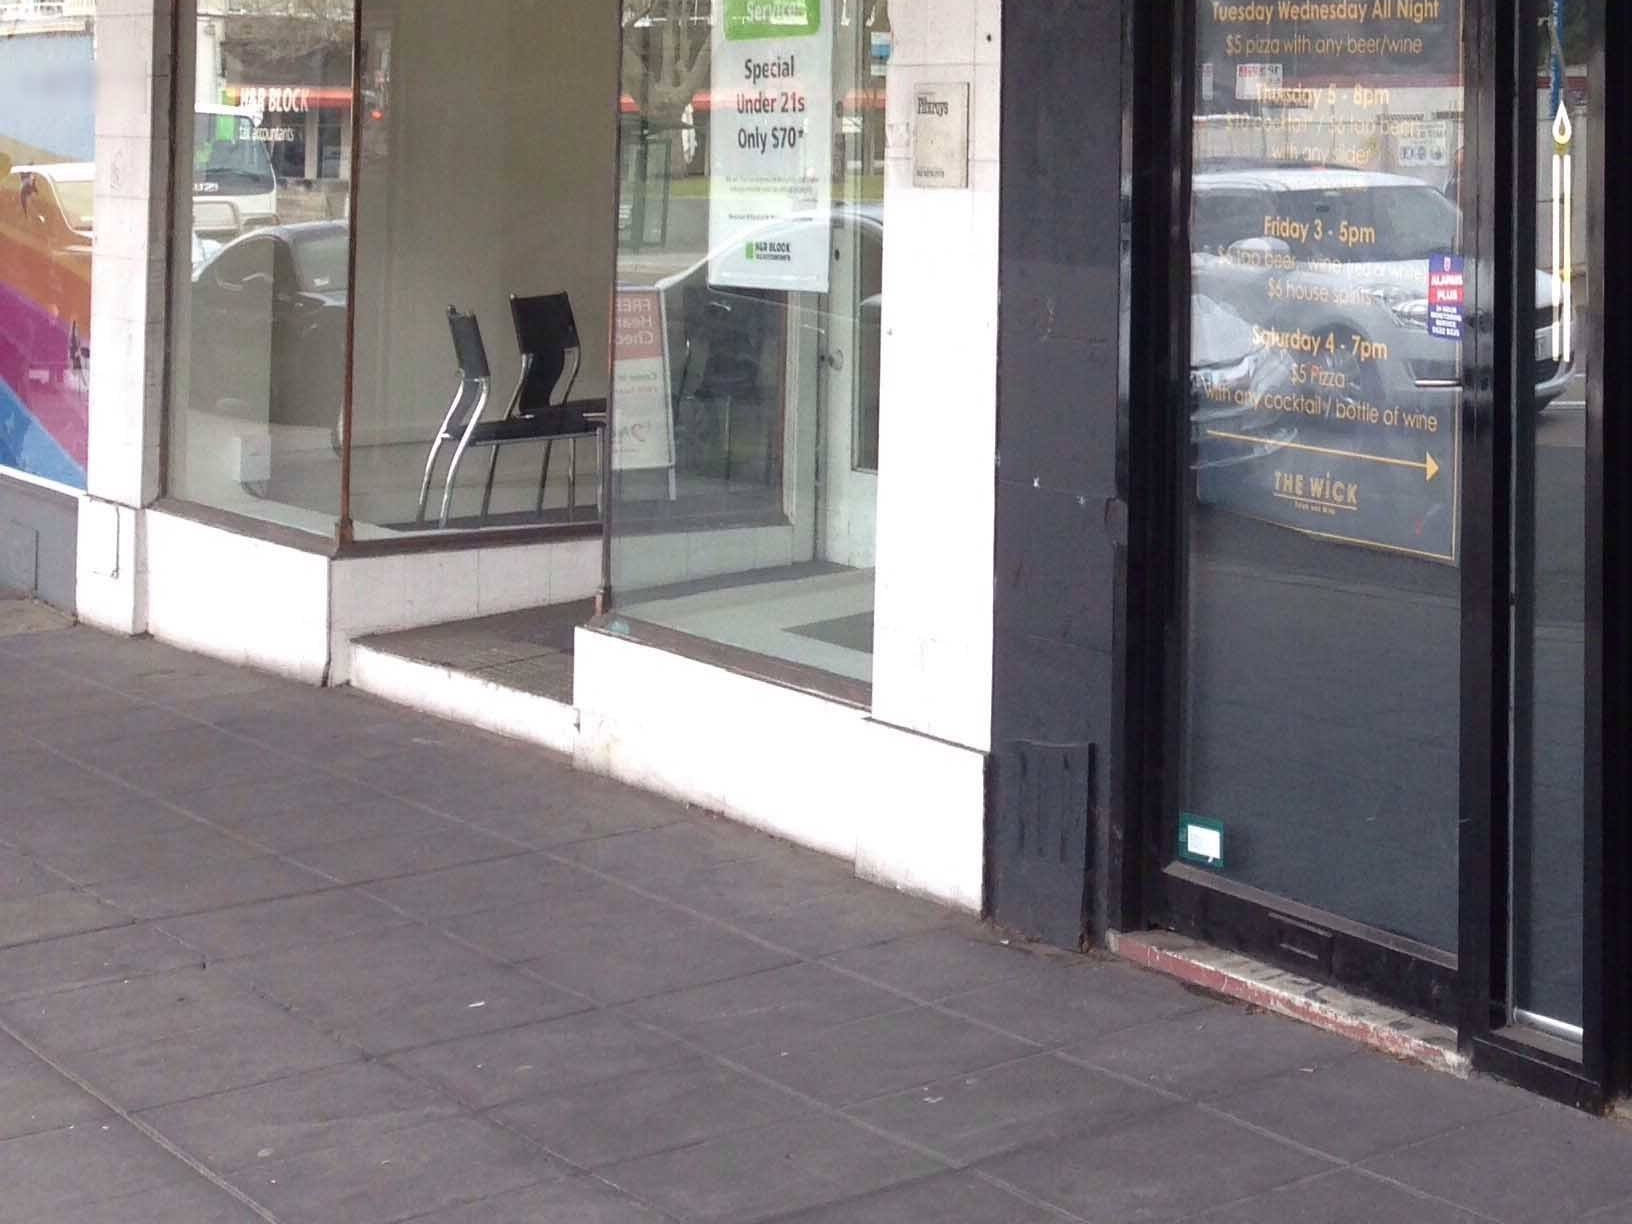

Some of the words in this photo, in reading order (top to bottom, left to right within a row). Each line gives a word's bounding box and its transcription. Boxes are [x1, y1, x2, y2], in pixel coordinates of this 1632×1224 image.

[1213, 0, 1273, 24] Tuesday
[1397, 0, 1440, 23] Night
[1225, 35, 1242, 54] $5
[1246, 36, 1281, 56] pizza
[1283, 34, 1311, 53] with
[1315, 38, 1343, 57] any
[1347, 34, 1422, 55] beer/wine
[745, 55, 794, 85] Special
[737, 91, 775, 114] Under
[780, 92, 805, 112] 21s
[738, 127, 767, 154] Only
[1264, 216, 1310, 242] Friday
[1314, 219, 1323, 241] 3
[1338, 219, 1375, 248] 5pm
[1286, 279, 1329, 301] house
[1252, 326, 1321, 356] Saturday
[1325, 331, 1335, 352] 4
[1351, 335, 1387, 362] 7pm
[1291, 364, 1307, 384] $5
[1311, 366, 1344, 389] Pizza
[1204, 382, 1230, 404] with
[1265, 391, 1321, 416] cocktail
[1336, 398, 1377, 425] bottle
[1384, 402, 1400, 426] of
[1403, 408, 1437, 433] wine
[1274, 471, 1303, 496] THE
